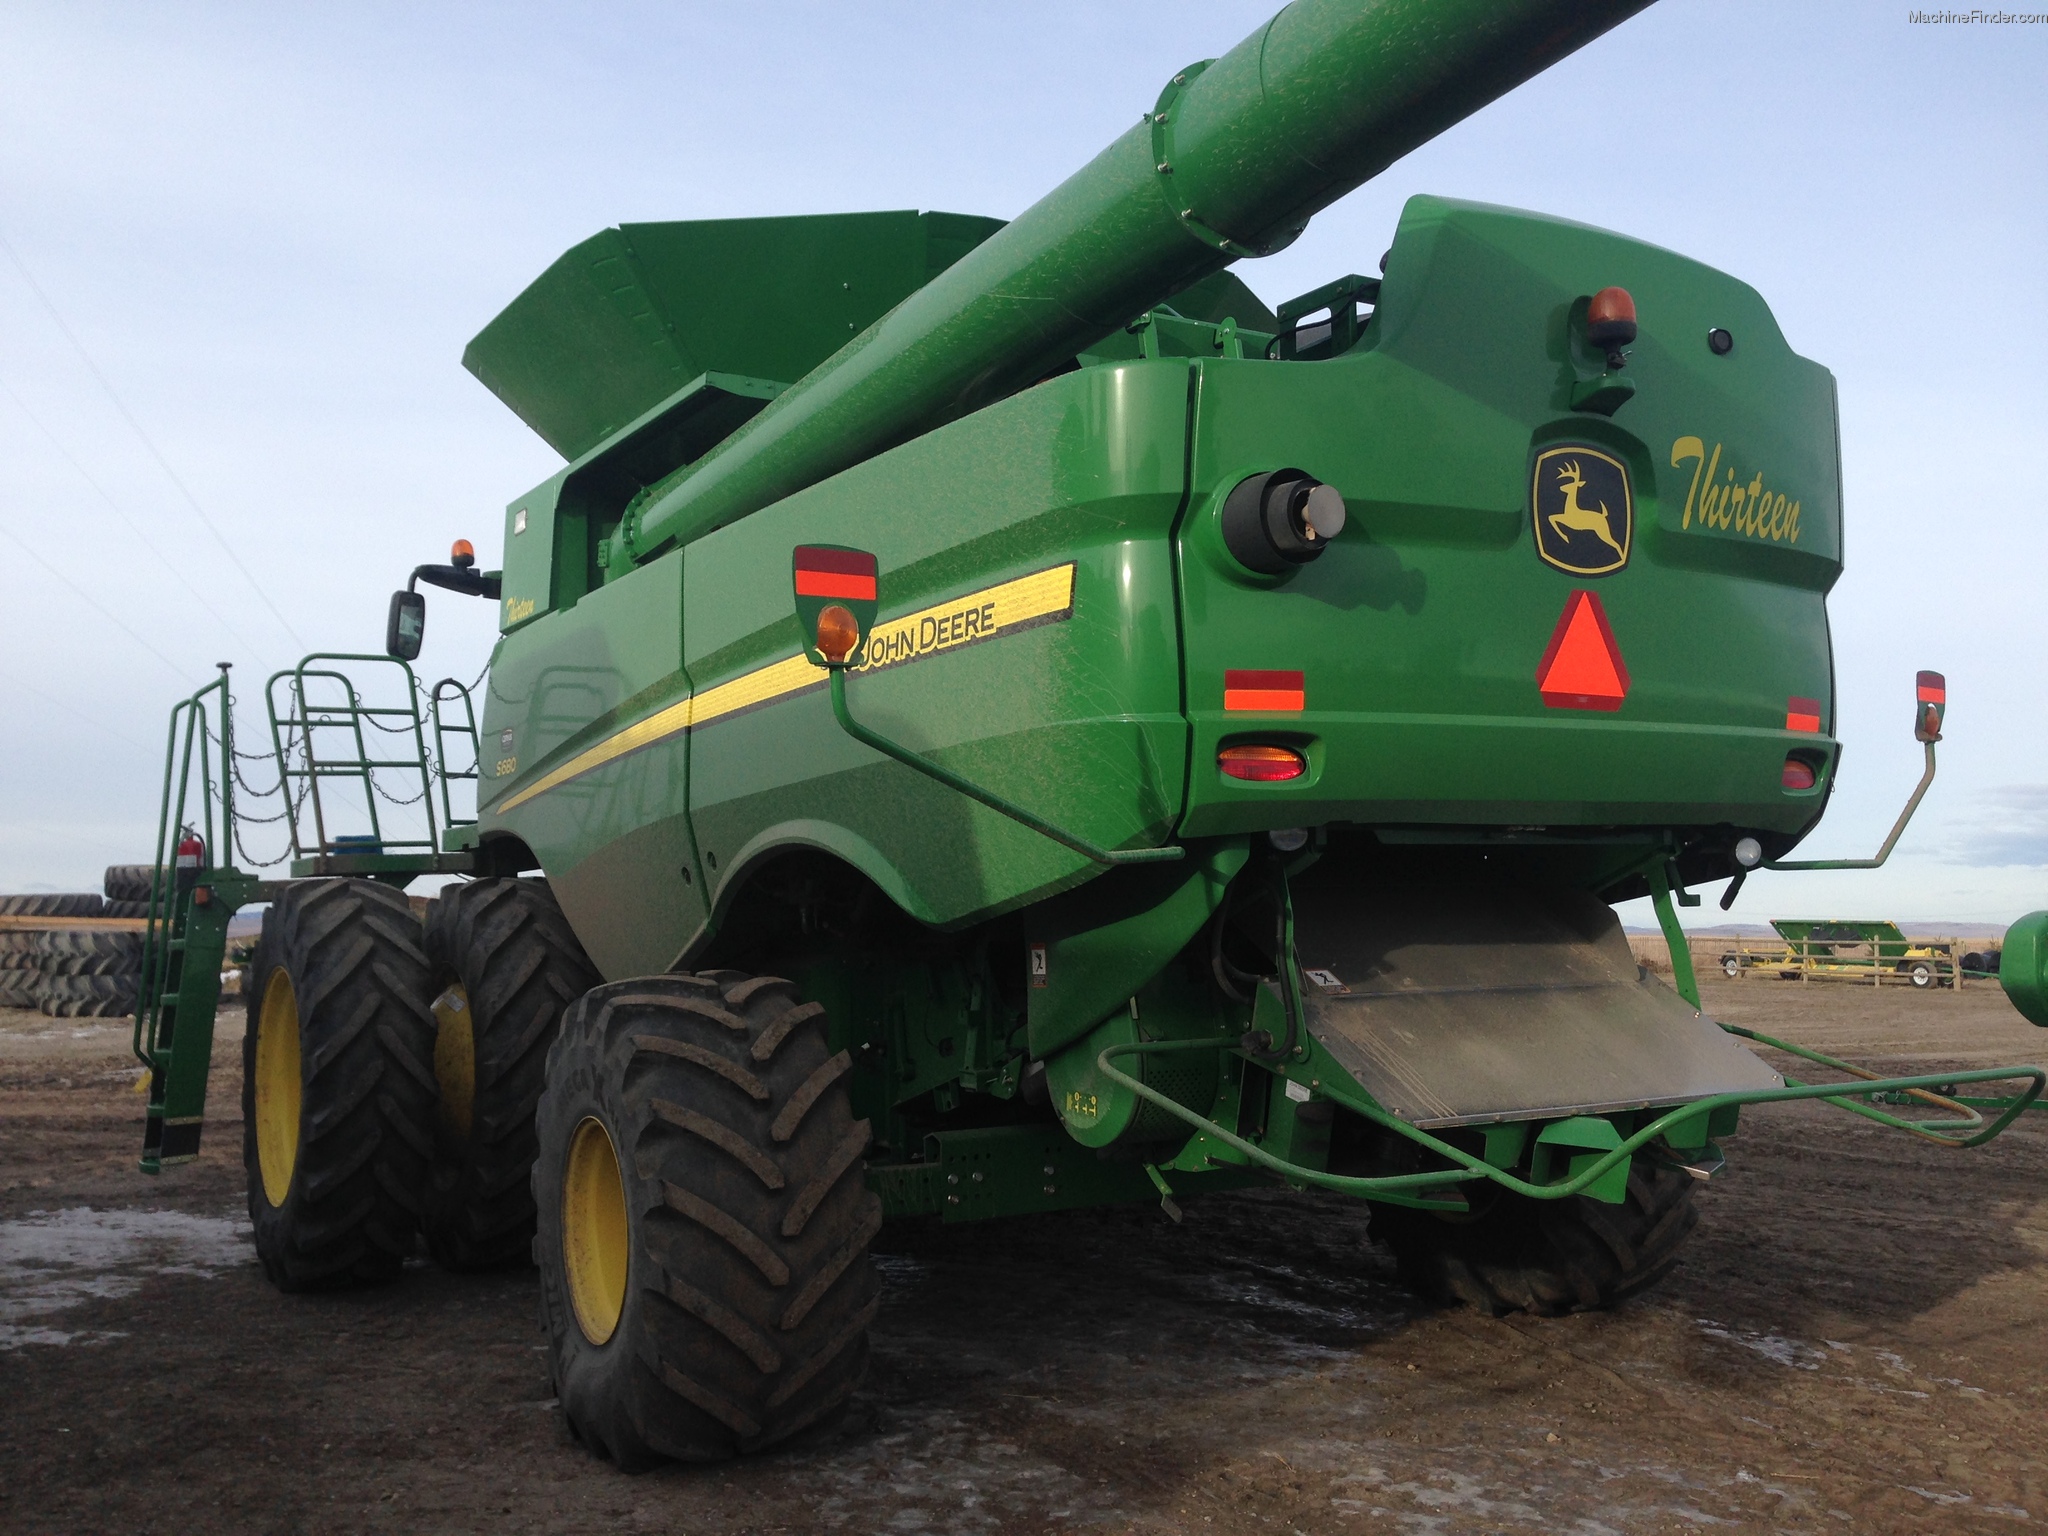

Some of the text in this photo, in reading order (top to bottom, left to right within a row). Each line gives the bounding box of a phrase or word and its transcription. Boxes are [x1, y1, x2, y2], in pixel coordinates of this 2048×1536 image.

[1670, 435, 1801, 544] Thirteen
[859, 602, 995, 667] JOHN DEERE
[496, 757, 517, 777] S680
